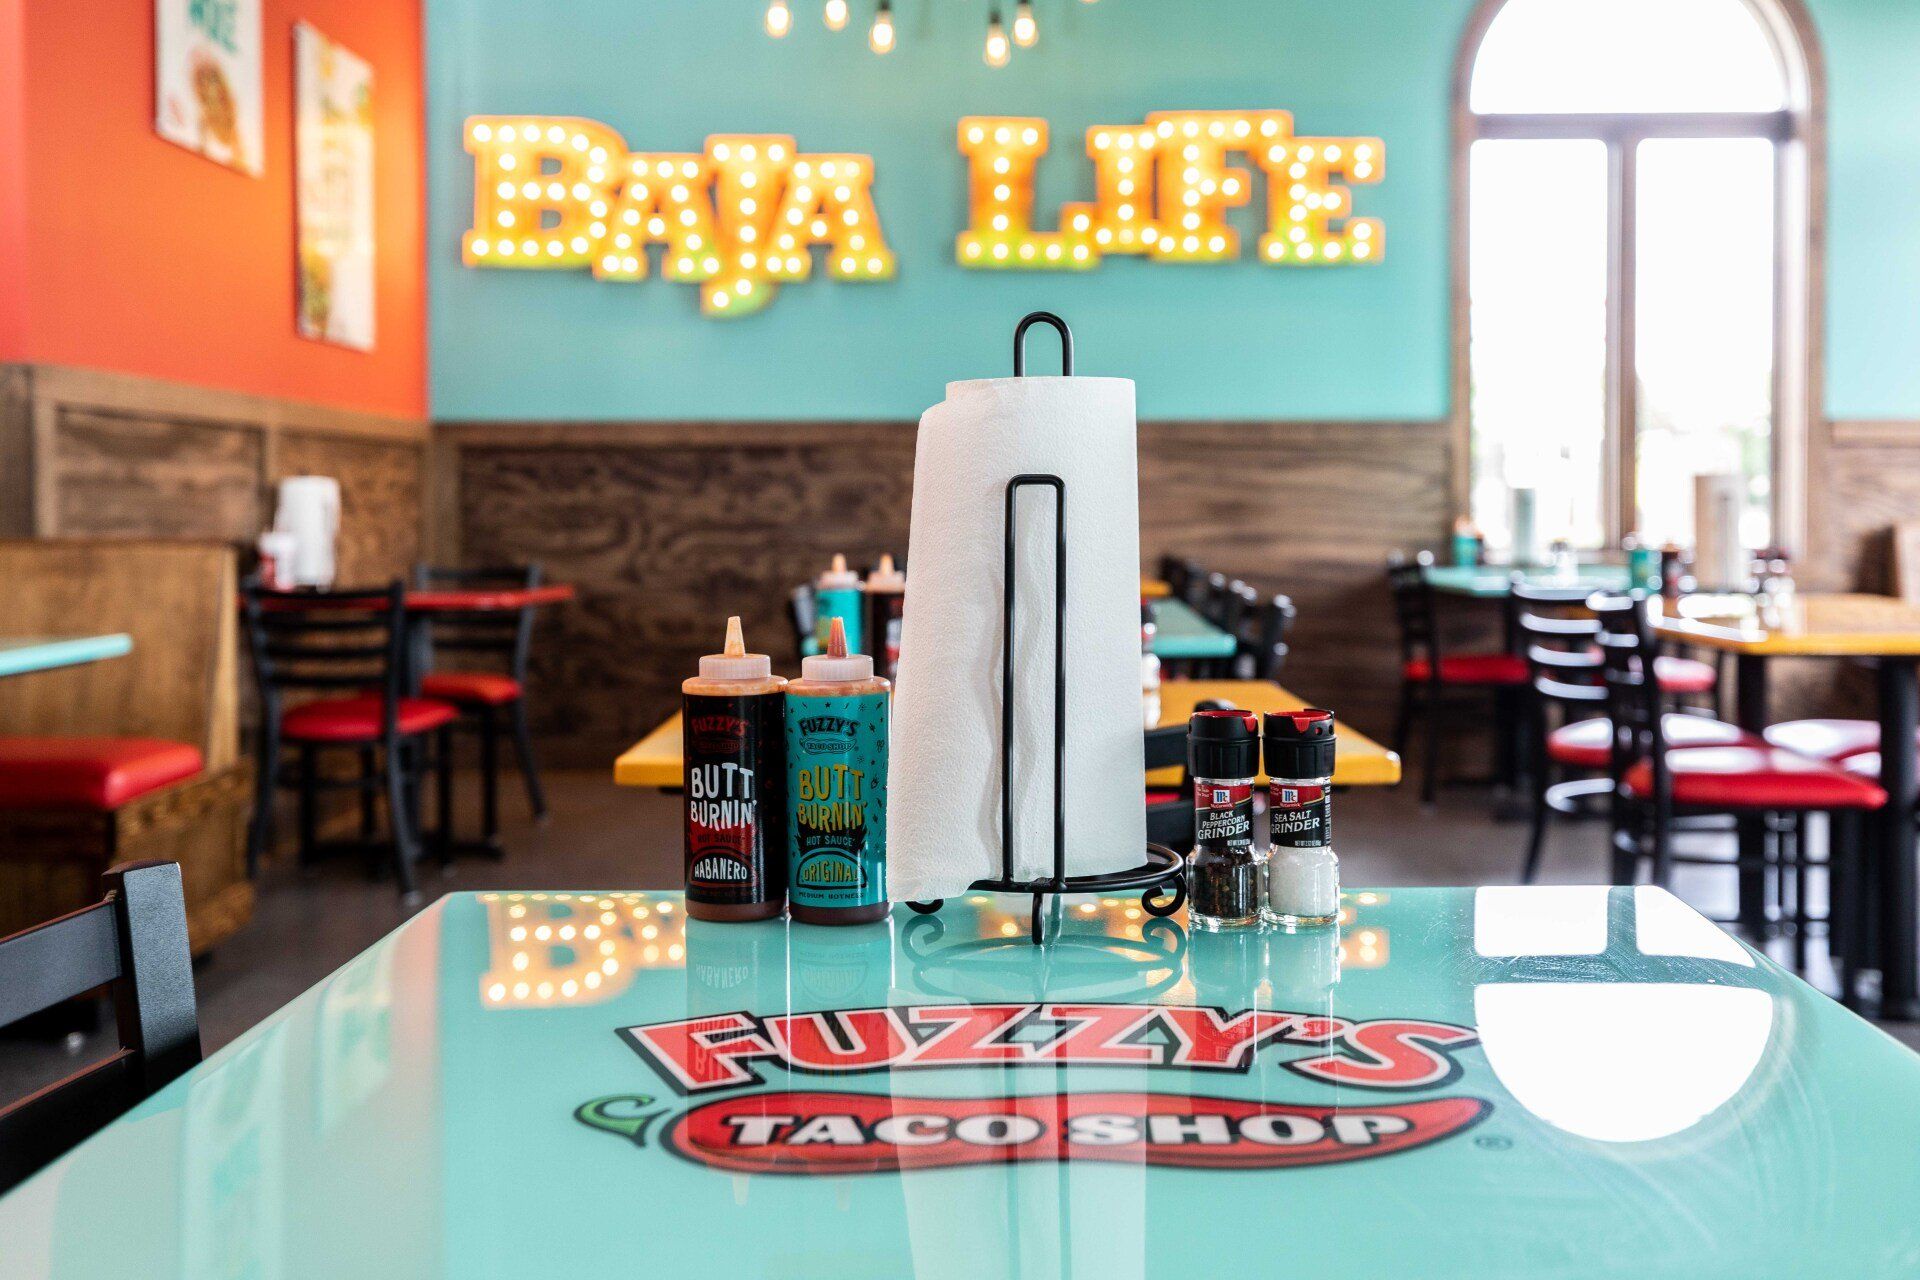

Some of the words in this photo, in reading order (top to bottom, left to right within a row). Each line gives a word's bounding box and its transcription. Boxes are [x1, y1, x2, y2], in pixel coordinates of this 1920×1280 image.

[462, 115, 897, 319] BAJA
[956, 109, 1387, 271] LIFE
[798, 715, 860, 737] FUZZY'S
[691, 762, 753, 799] BUTT
[799, 764, 865, 801] BUTT
[690, 800, 758, 831] BURNIN'
[798, 801, 867, 833] BURNIN'
[1202, 814, 1246, 829] PEPPERCORN
[1210, 810, 1234, 821] BLACK
[1271, 817, 1321, 834] GRINDER
[1274, 813, 1288, 822] SEA
[1289, 810, 1311, 821] SALT
[806, 835, 821, 846] HOT
[825, 835, 853, 847] SAUCE
[1197, 820, 1250, 840] GRINDER
[694, 859, 747, 880] HABANERO
[614, 1004, 1482, 1096] FUZZY'S
[722, 1113, 1046, 1147] TACO
[1066, 1113, 1412, 1147] SHOP
